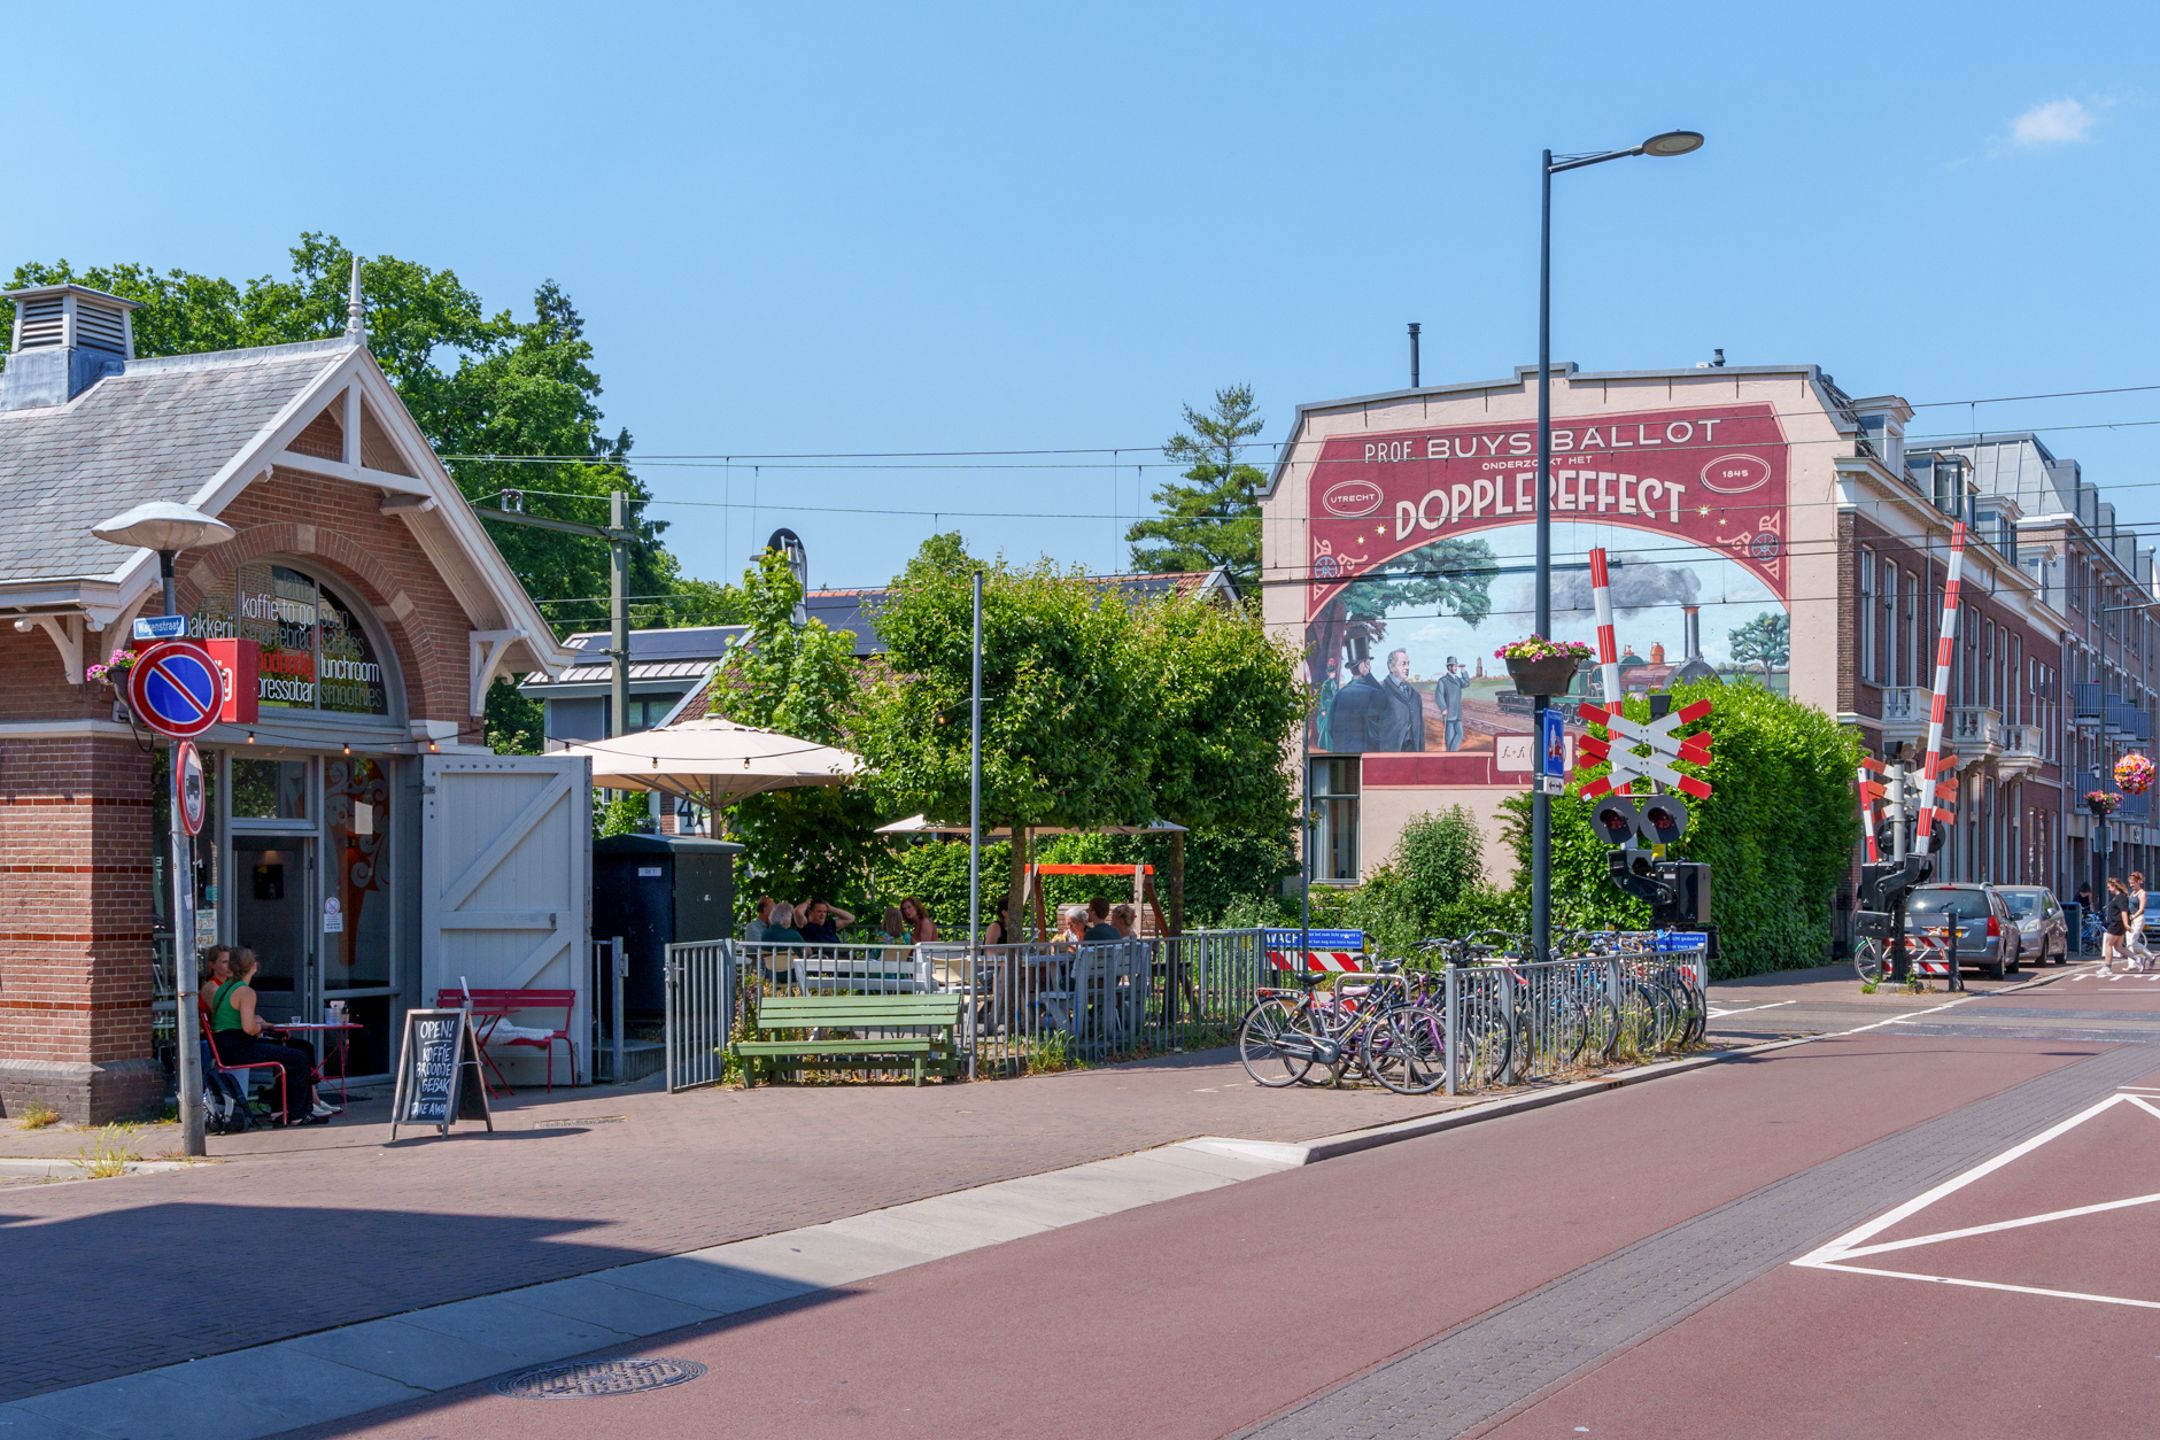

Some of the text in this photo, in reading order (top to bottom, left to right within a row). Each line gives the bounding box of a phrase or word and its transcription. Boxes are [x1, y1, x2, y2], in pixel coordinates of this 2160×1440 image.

[1364, 419, 1721, 464] PROF. BUYS BALLOT
[1482, 455, 1592, 471] ONDERZOKT HET
[1722, 469, 1749, 478] 1845
[1330, 493, 1376, 504] UTRECHT
[241, 591, 279, 622] koffie
[282, 598, 295, 624] to
[299, 604, 314, 631] go
[137, 619, 181, 636] Wagenstraat
[321, 653, 380, 683] lunchroom
[257, 676, 316, 702] ressobar
[1266, 933, 1303, 944] WACH
[420, 1020, 454, 1039] OPEN!
[422, 1077, 450, 1095] GEBAK
[429, 1102, 448, 1116] AWA
